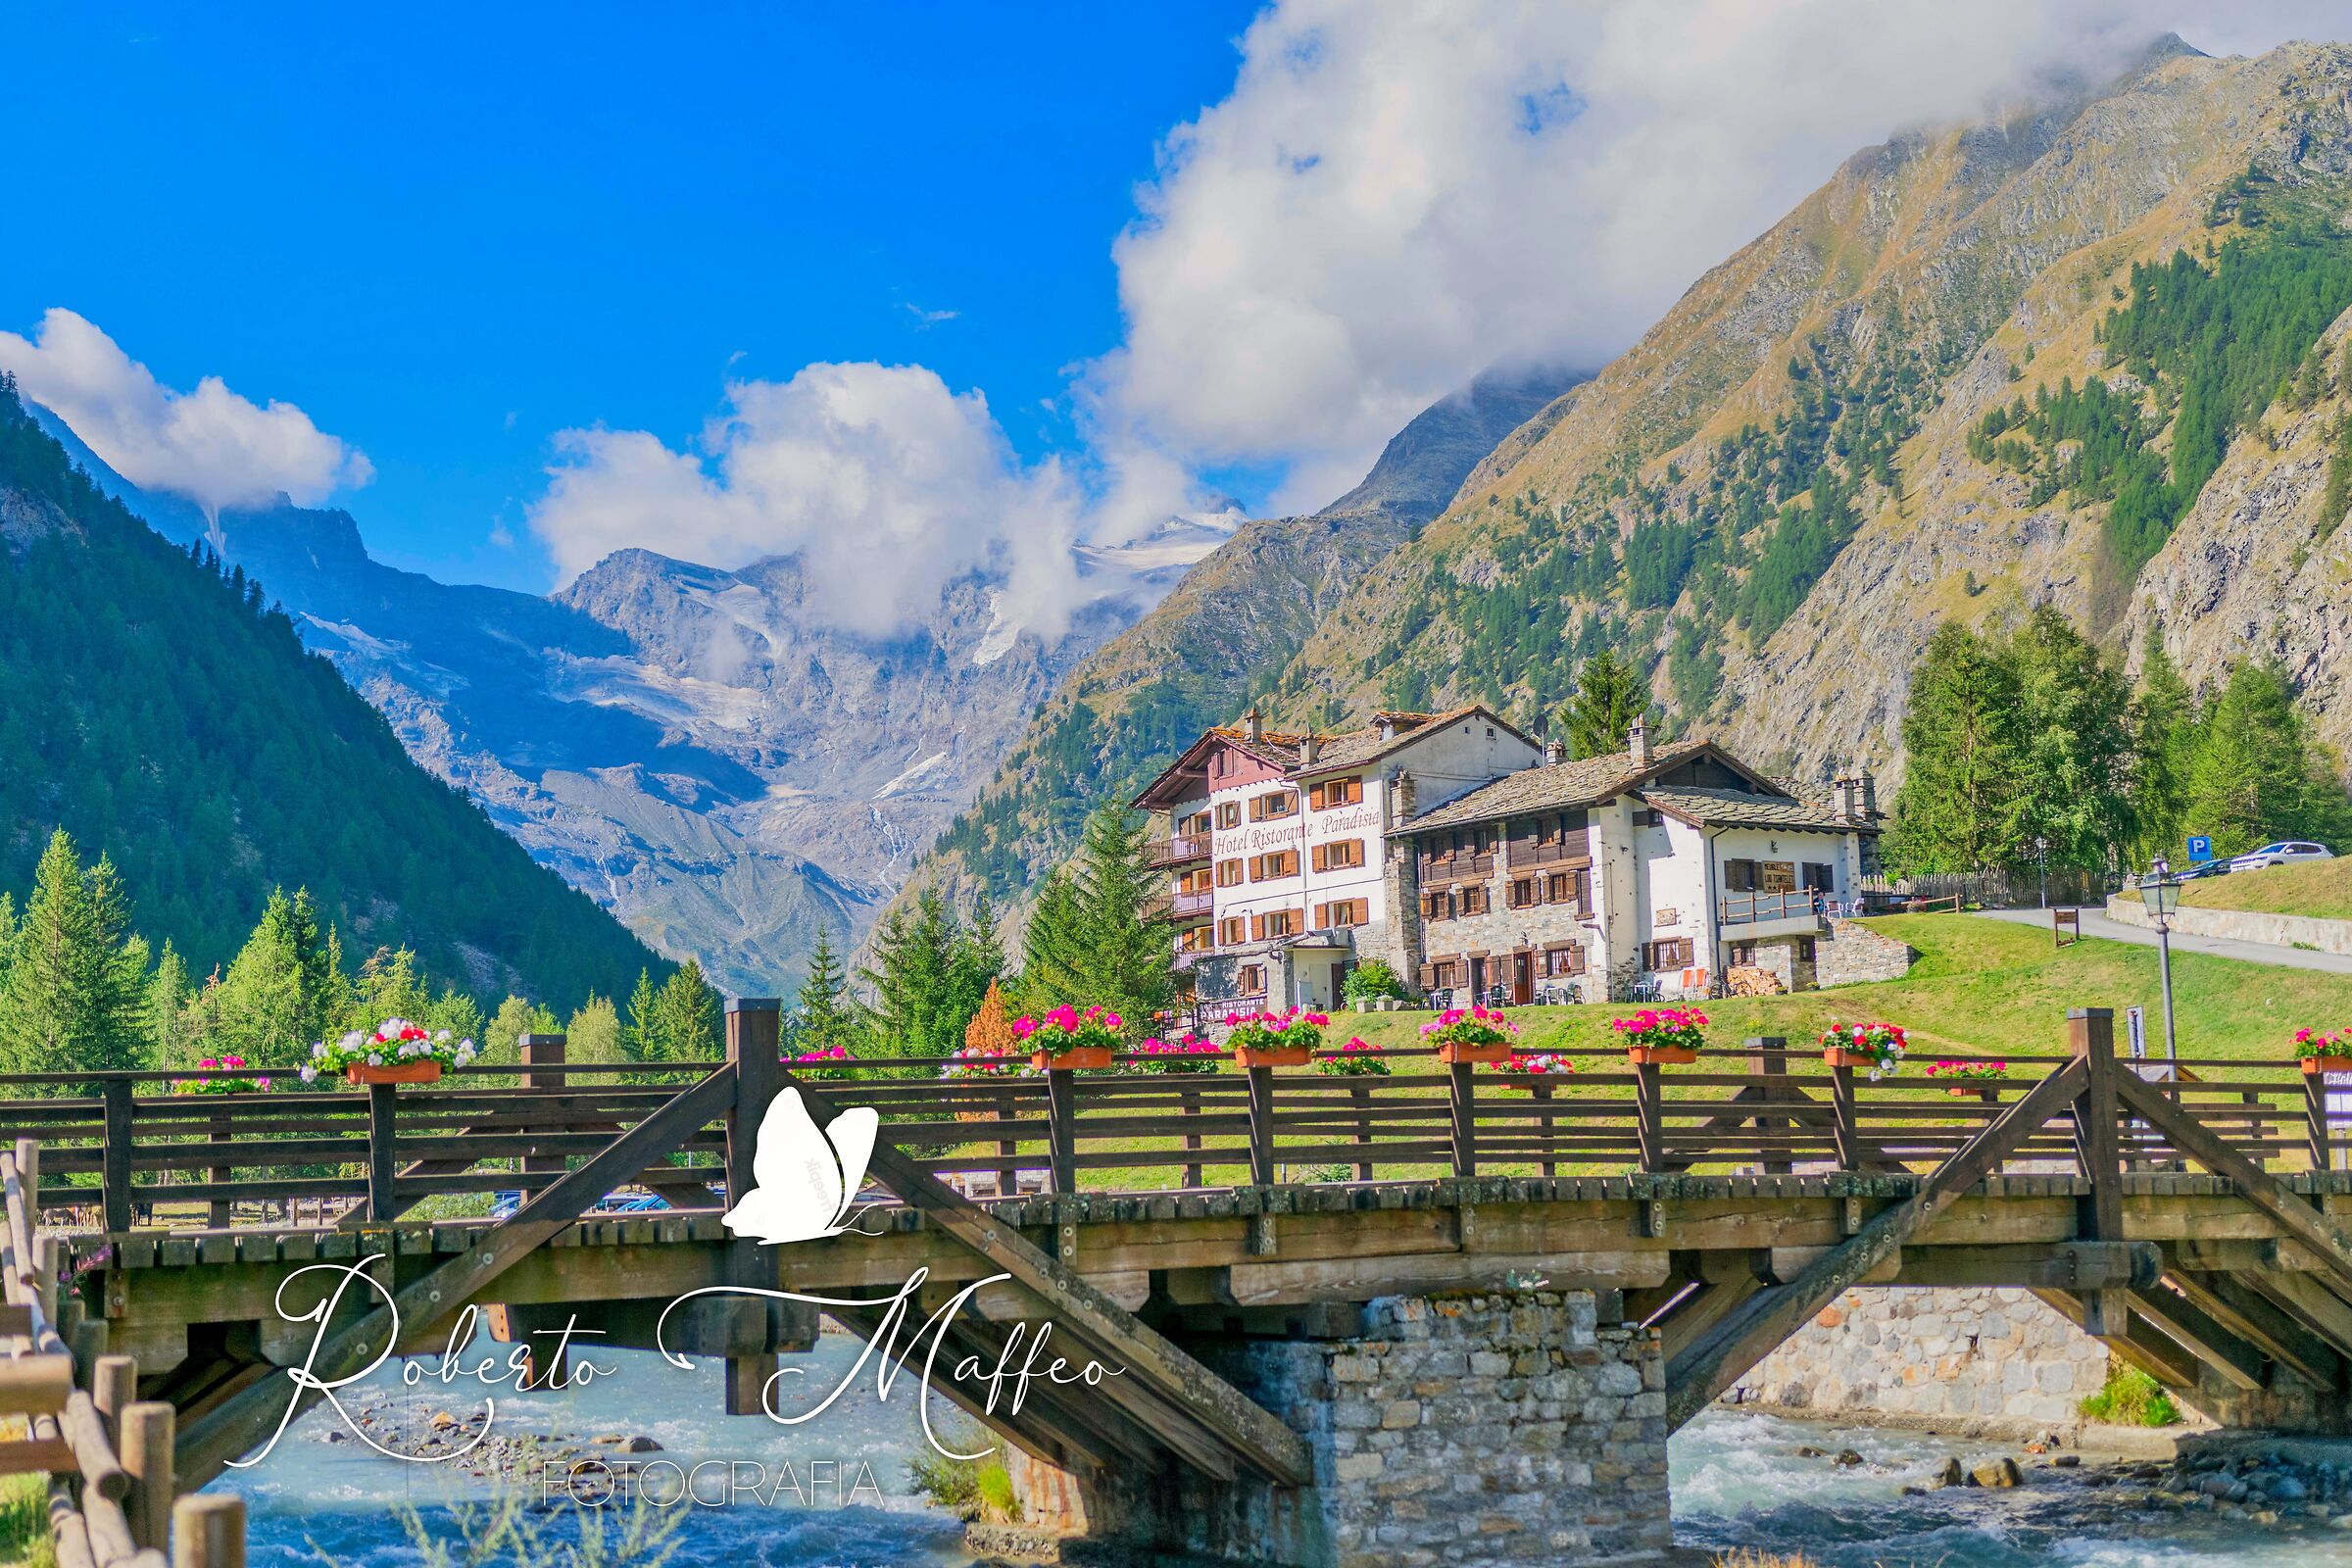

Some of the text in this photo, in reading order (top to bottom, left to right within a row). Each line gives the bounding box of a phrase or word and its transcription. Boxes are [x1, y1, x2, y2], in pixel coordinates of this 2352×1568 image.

[1214, 807, 1381, 857] Hotel Ristorante Paradisia
[2193, 839, 2205, 853] P
[1222, 999, 1264, 1008] RISTORANTE
